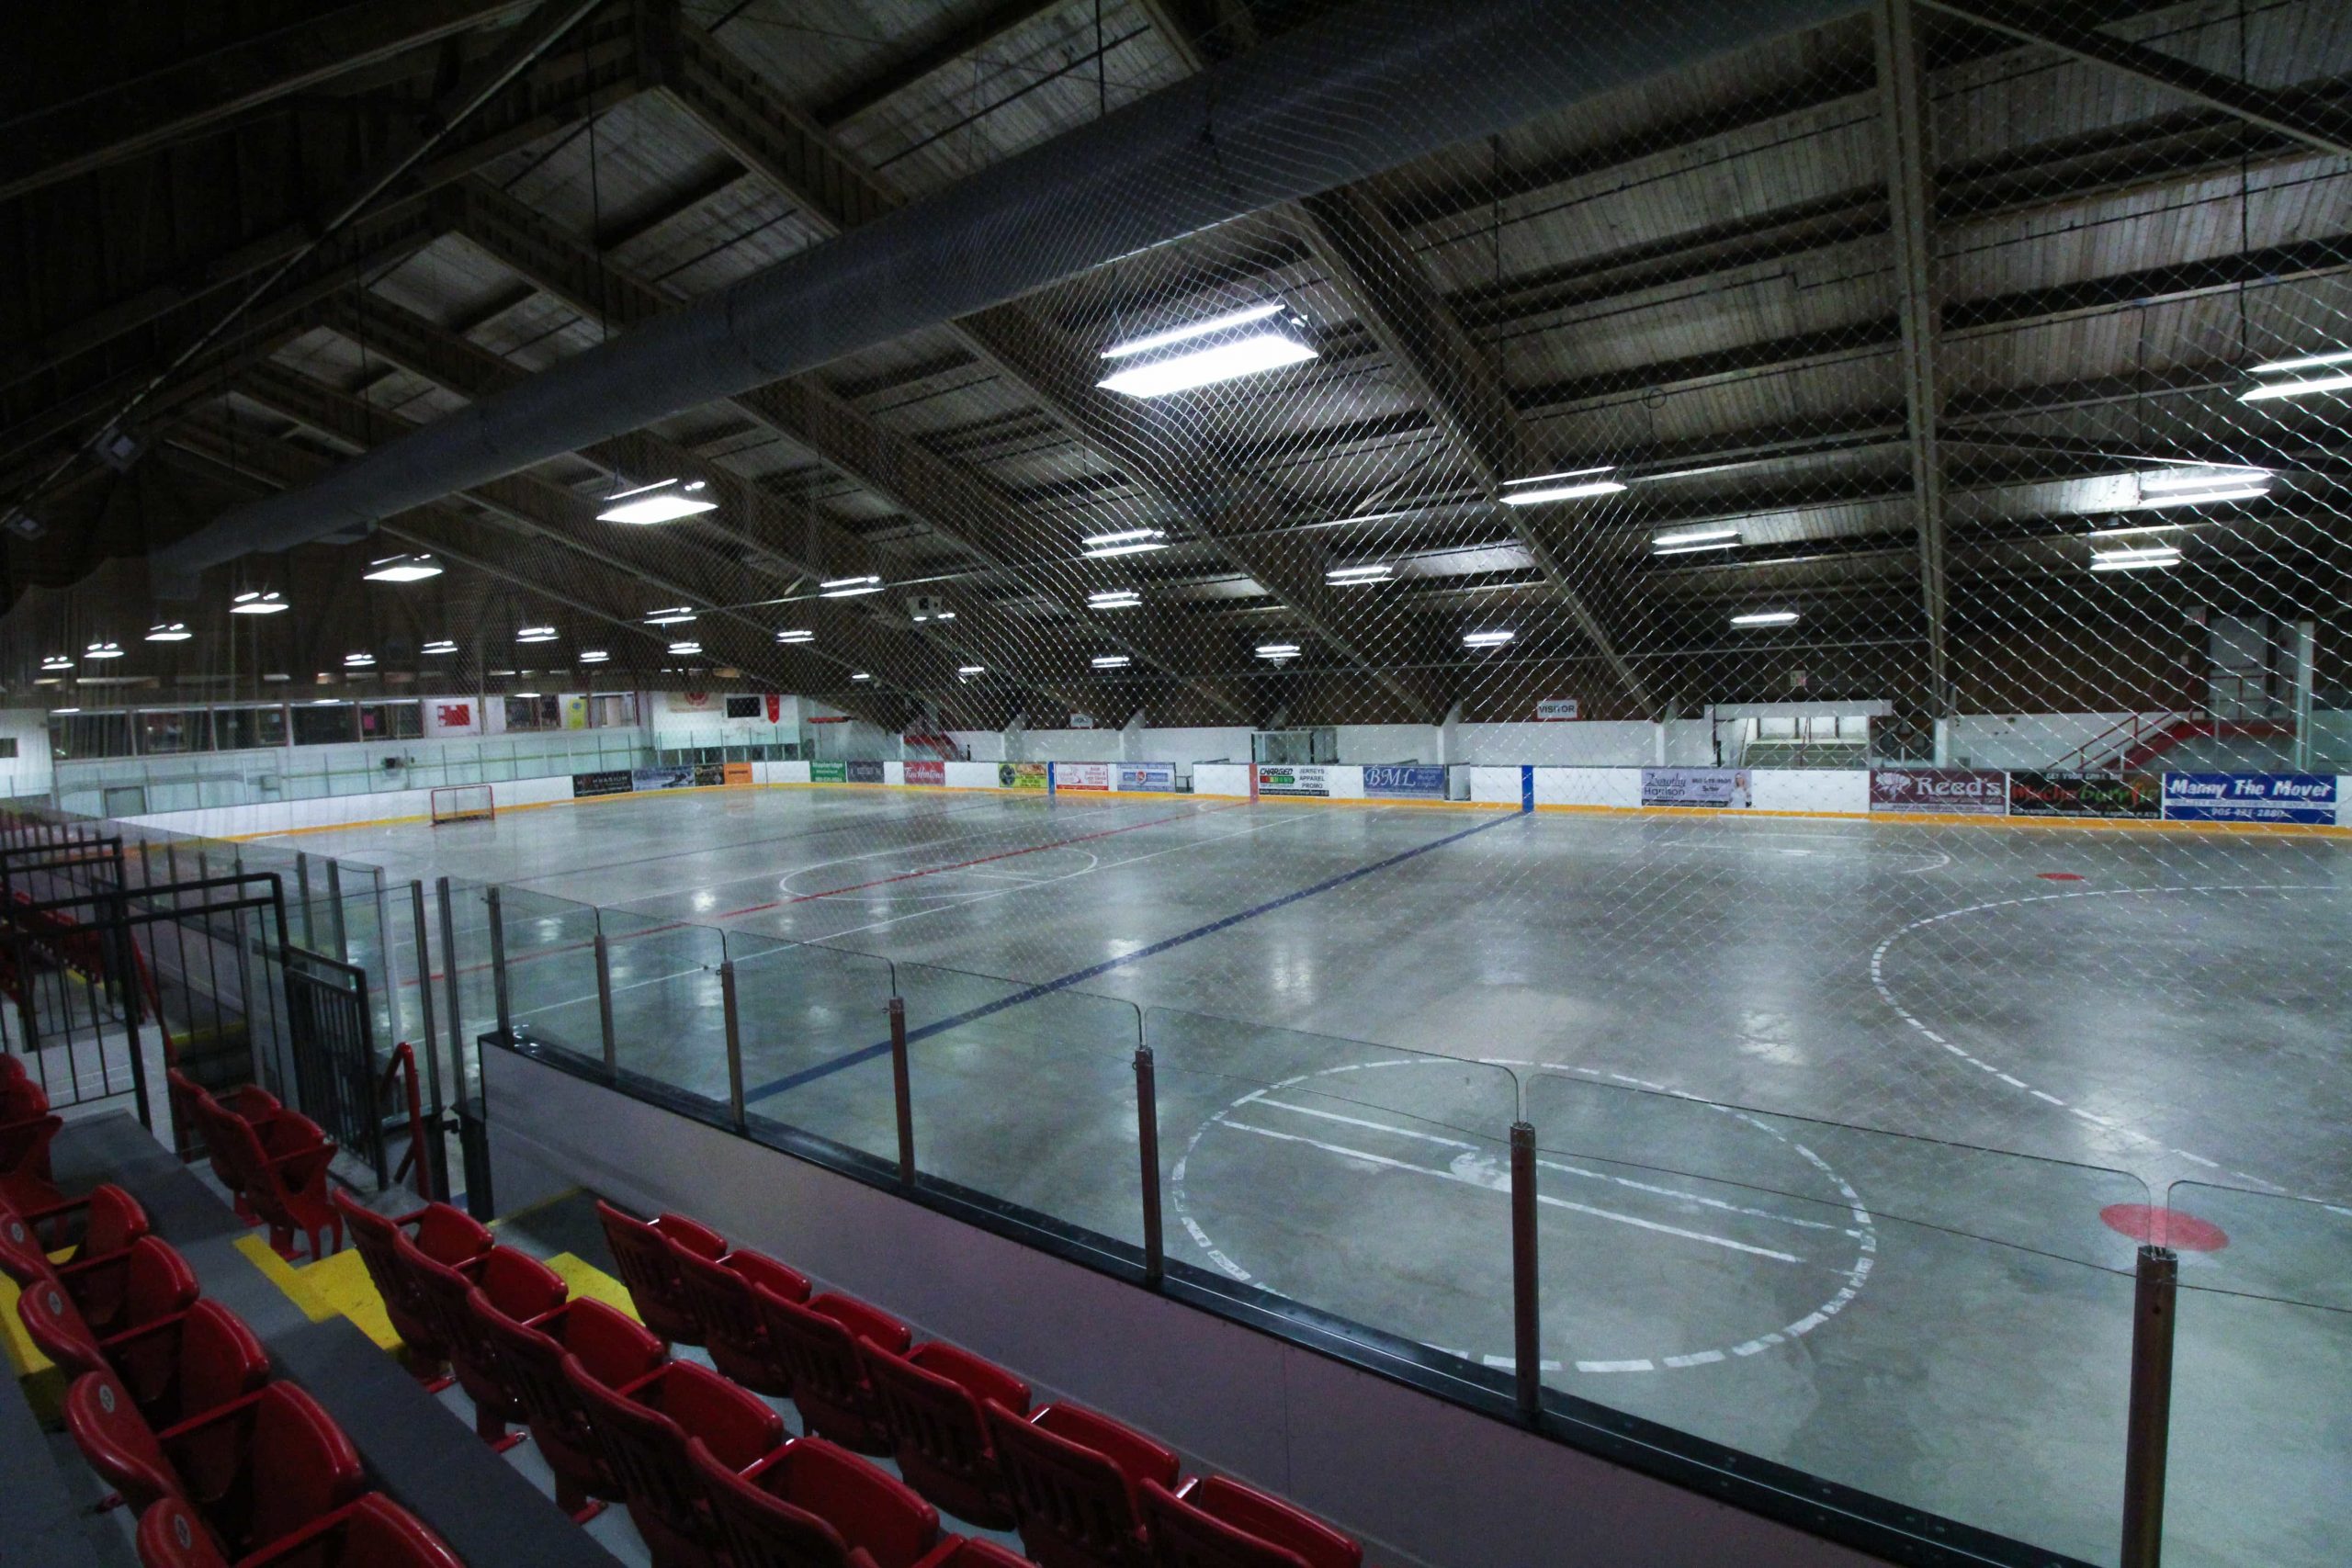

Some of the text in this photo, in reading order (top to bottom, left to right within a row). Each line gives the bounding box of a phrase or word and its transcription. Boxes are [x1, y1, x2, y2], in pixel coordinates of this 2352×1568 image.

[1538, 705, 1575, 714] VISITOR
[1364, 768, 1416, 787] BML
[1644, 787, 1685, 796] Harrison
[2170, 779, 2331, 798] Manny The Mover
